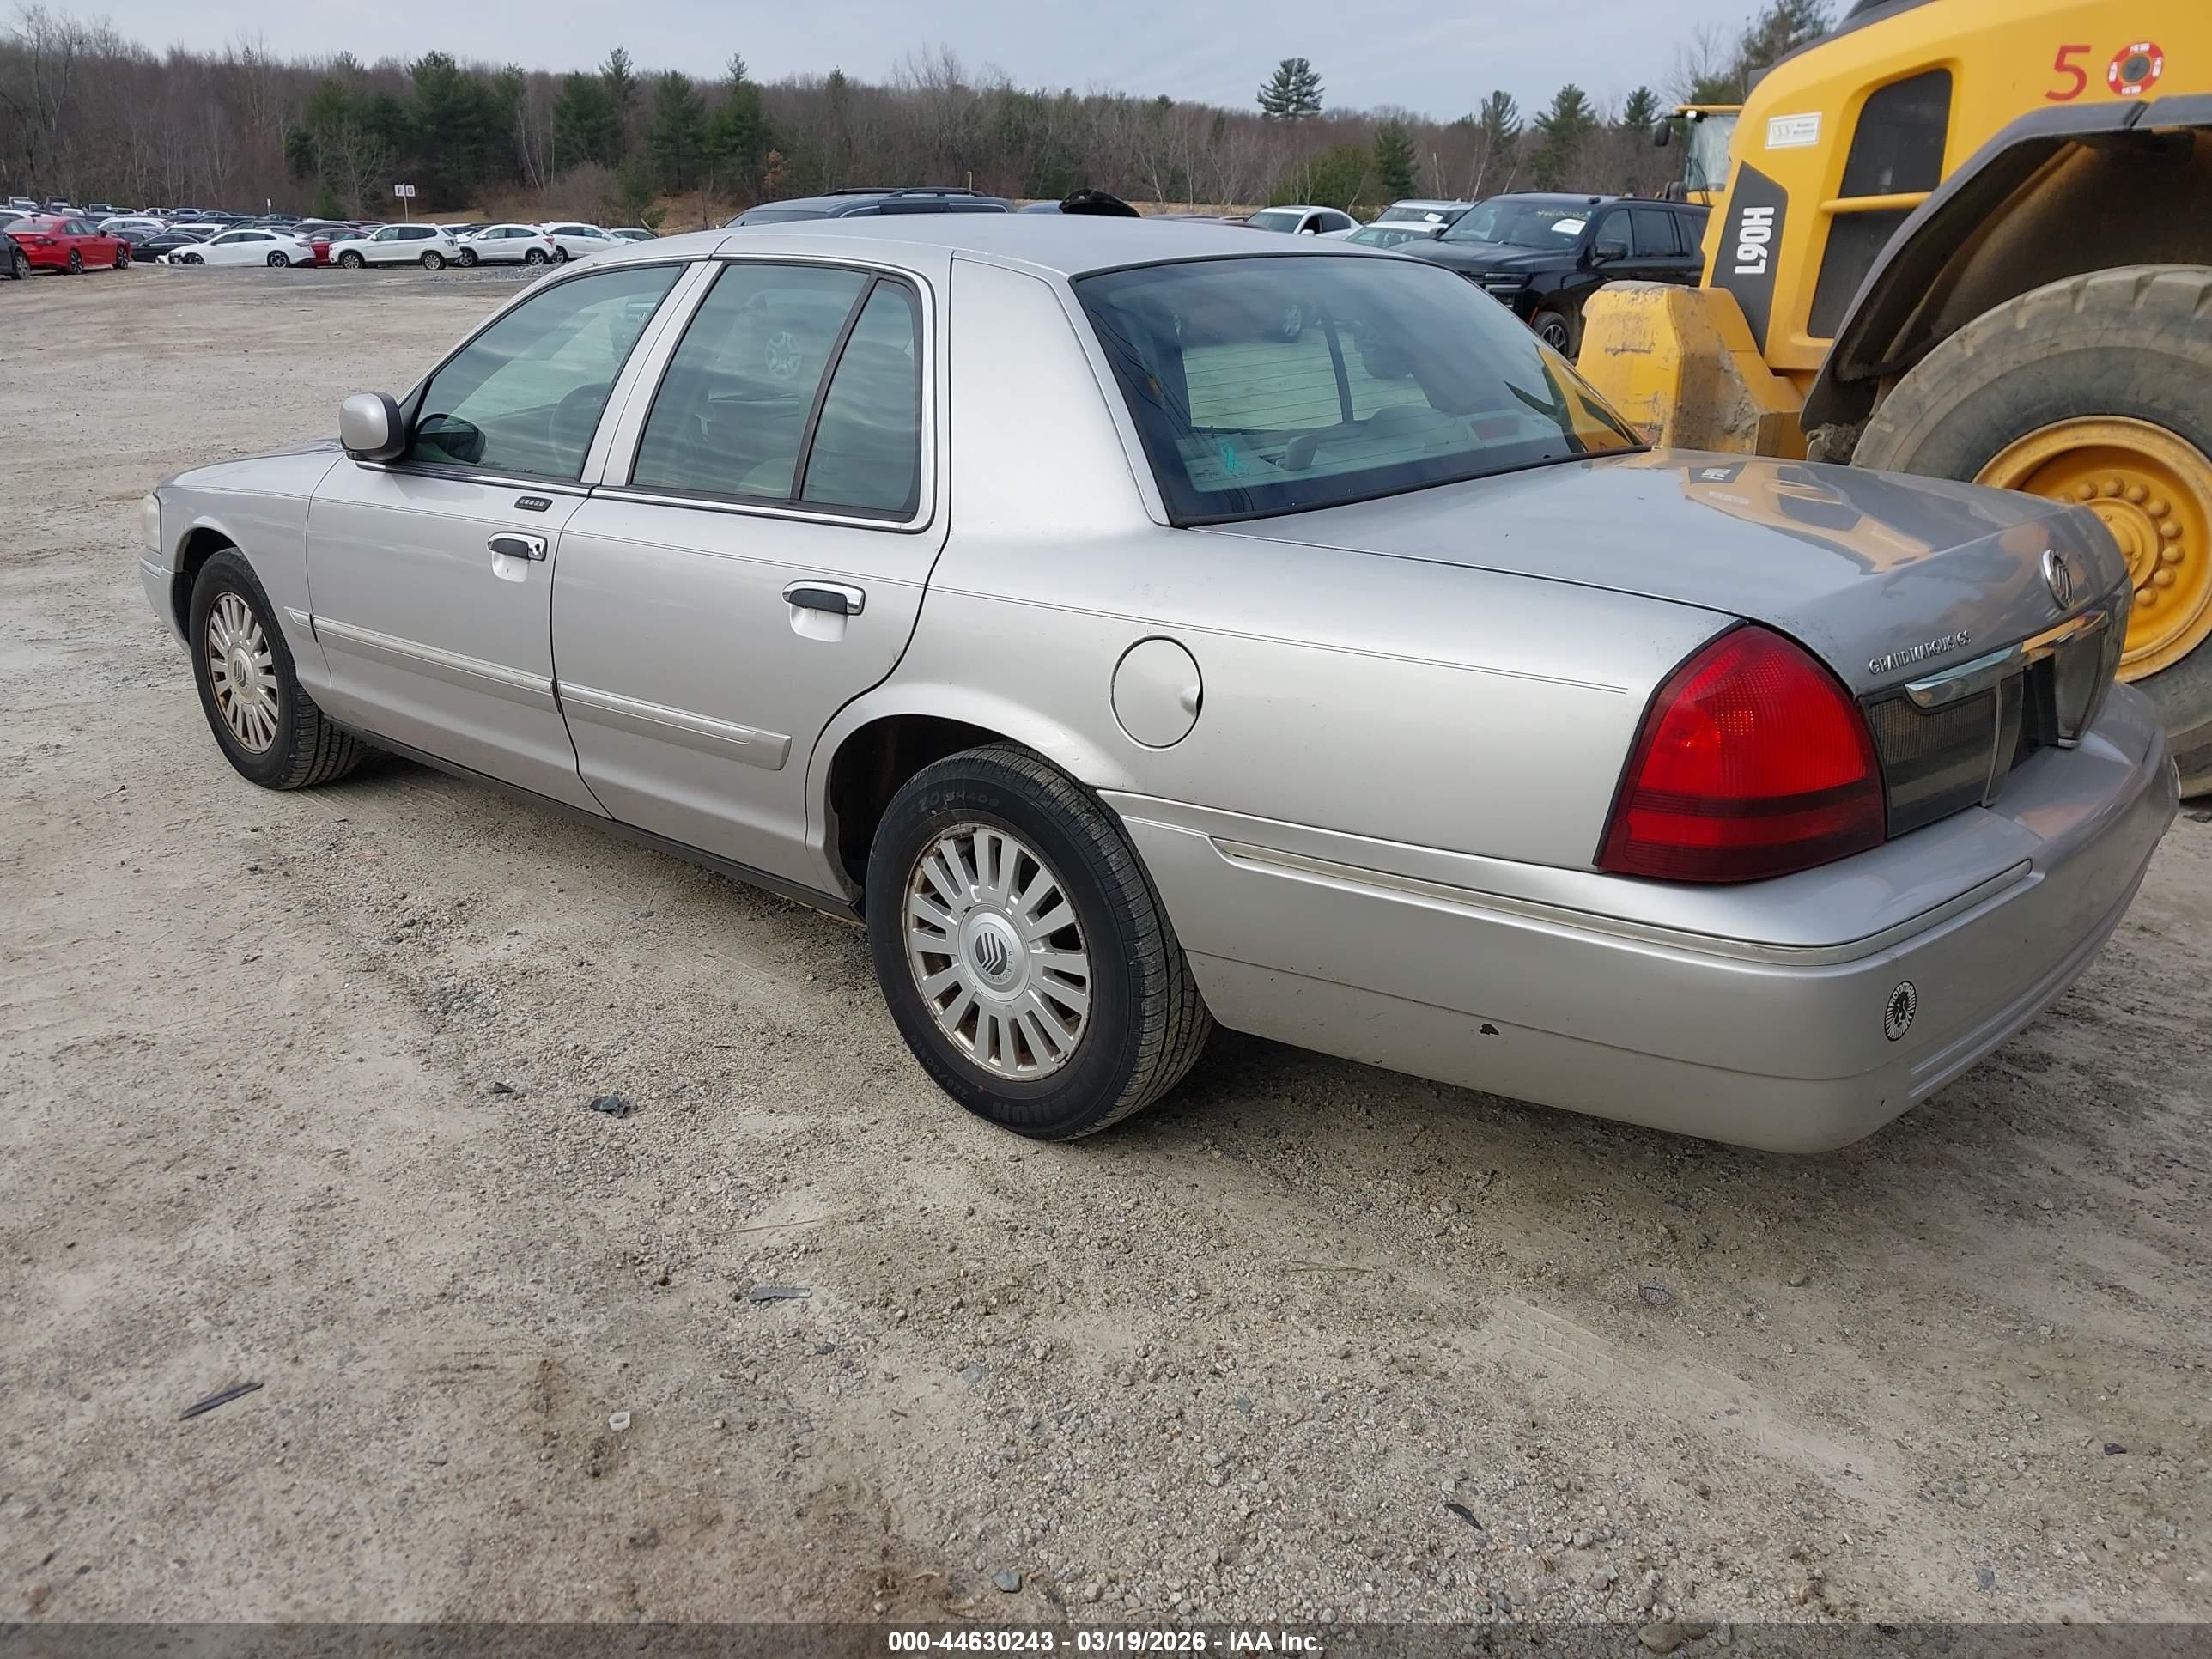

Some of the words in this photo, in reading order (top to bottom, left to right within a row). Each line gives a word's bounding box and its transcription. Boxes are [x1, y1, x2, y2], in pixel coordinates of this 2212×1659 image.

[2045, 45, 2091, 100] 5
[1735, 207, 1775, 274] L90H
[1869, 650, 1910, 675] GRAND
[1910, 635, 1955, 663] MARQUIS
